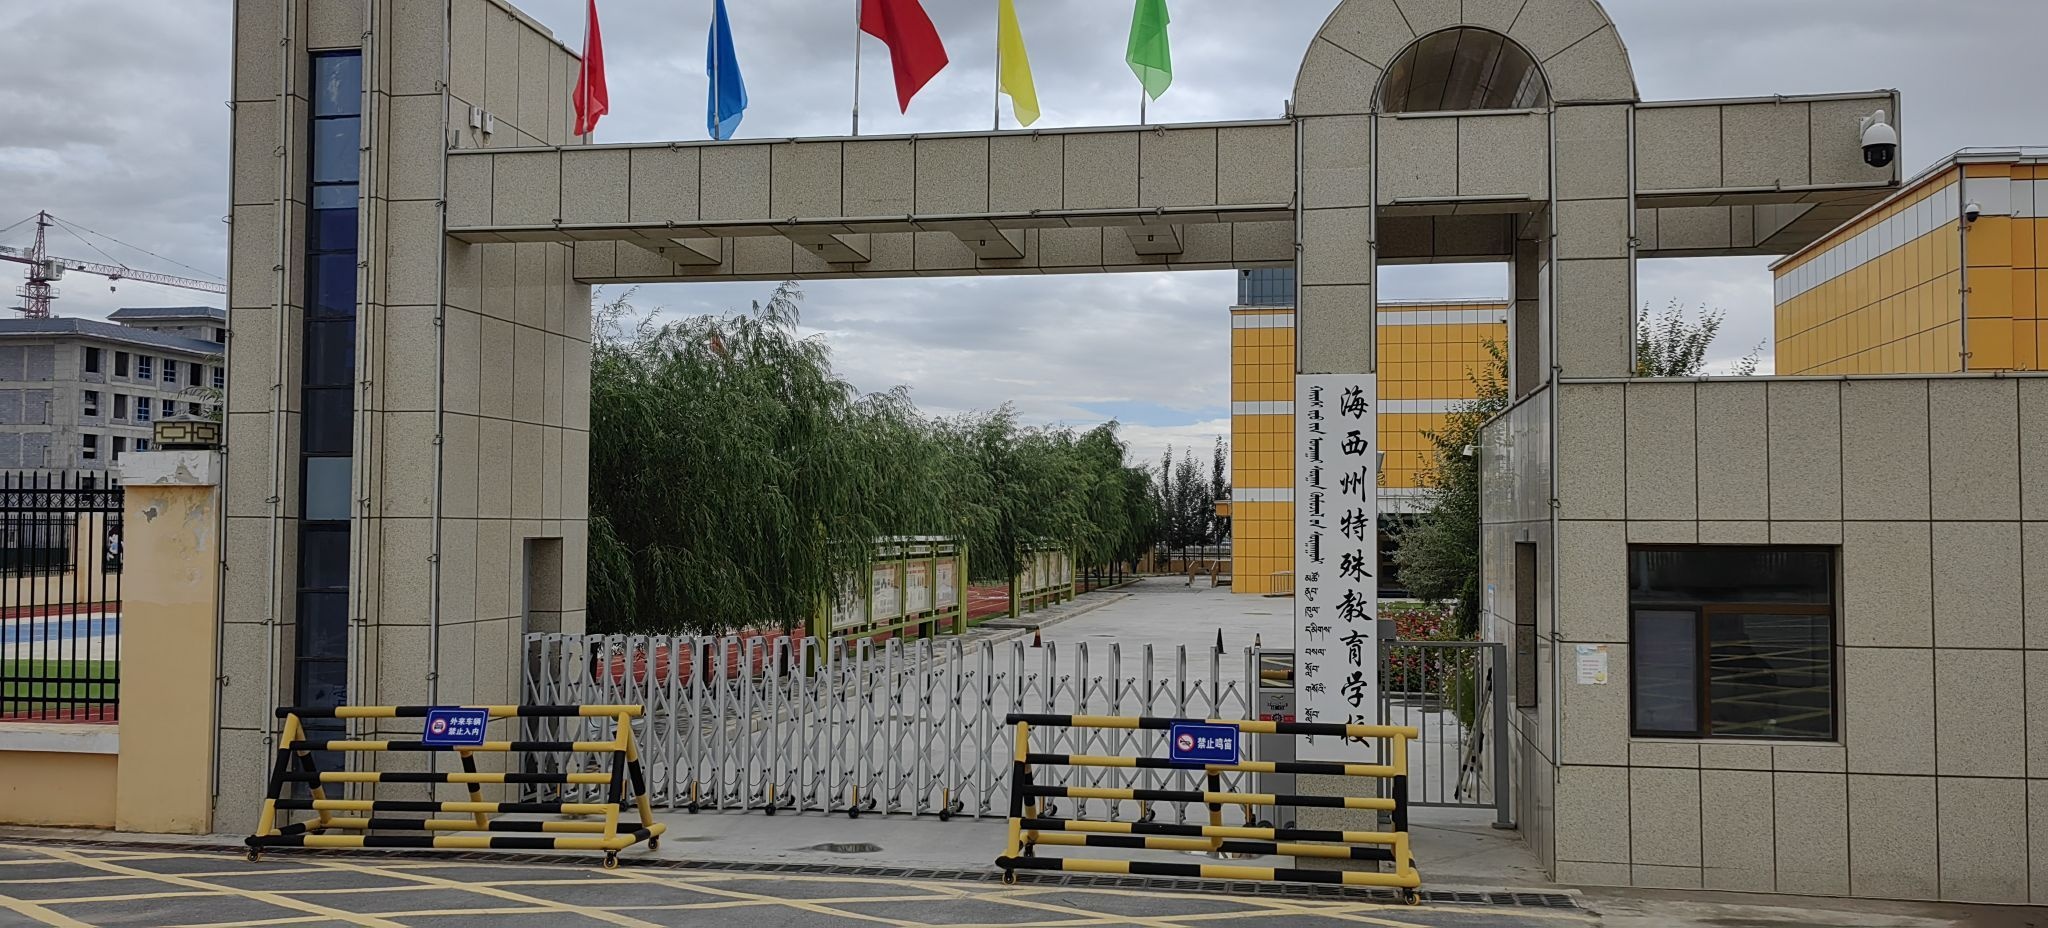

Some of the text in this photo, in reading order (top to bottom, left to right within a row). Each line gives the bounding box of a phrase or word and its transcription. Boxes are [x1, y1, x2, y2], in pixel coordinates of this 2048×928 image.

[1336, 384, 1373, 748] 海西州特殊教育学校
[450, 717, 482, 726] 外来车辆
[448, 727, 479, 736] 禁止入内
[1197, 737, 1233, 751] 禁止鸣笛
